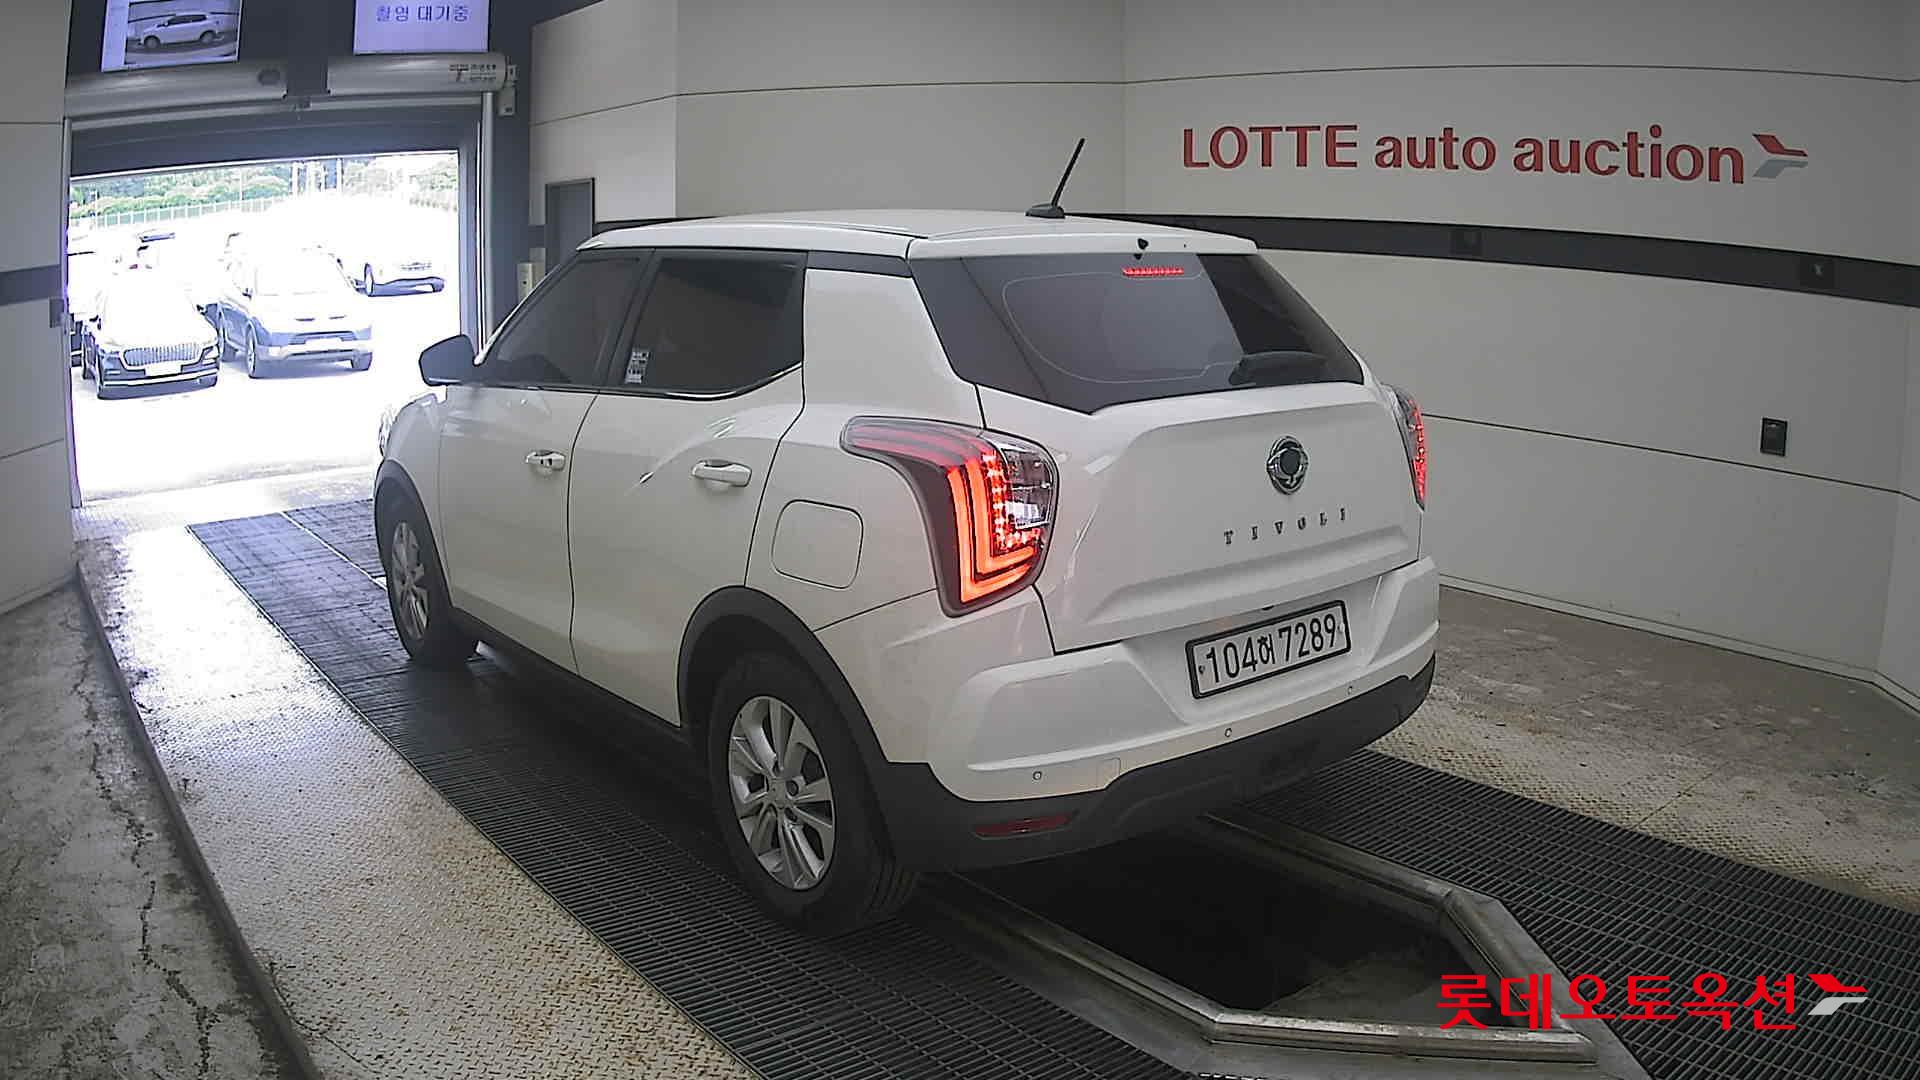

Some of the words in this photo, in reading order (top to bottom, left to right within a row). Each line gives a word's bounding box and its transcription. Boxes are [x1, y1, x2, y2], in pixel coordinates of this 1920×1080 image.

[417, 5, 468, 22] 대기중
[1183, 125, 1358, 169] LOTTE
[1375, 127, 1497, 172] auto
[1512, 125, 1744, 185] auction
[1223, 507, 1346, 545] TIVOLI
